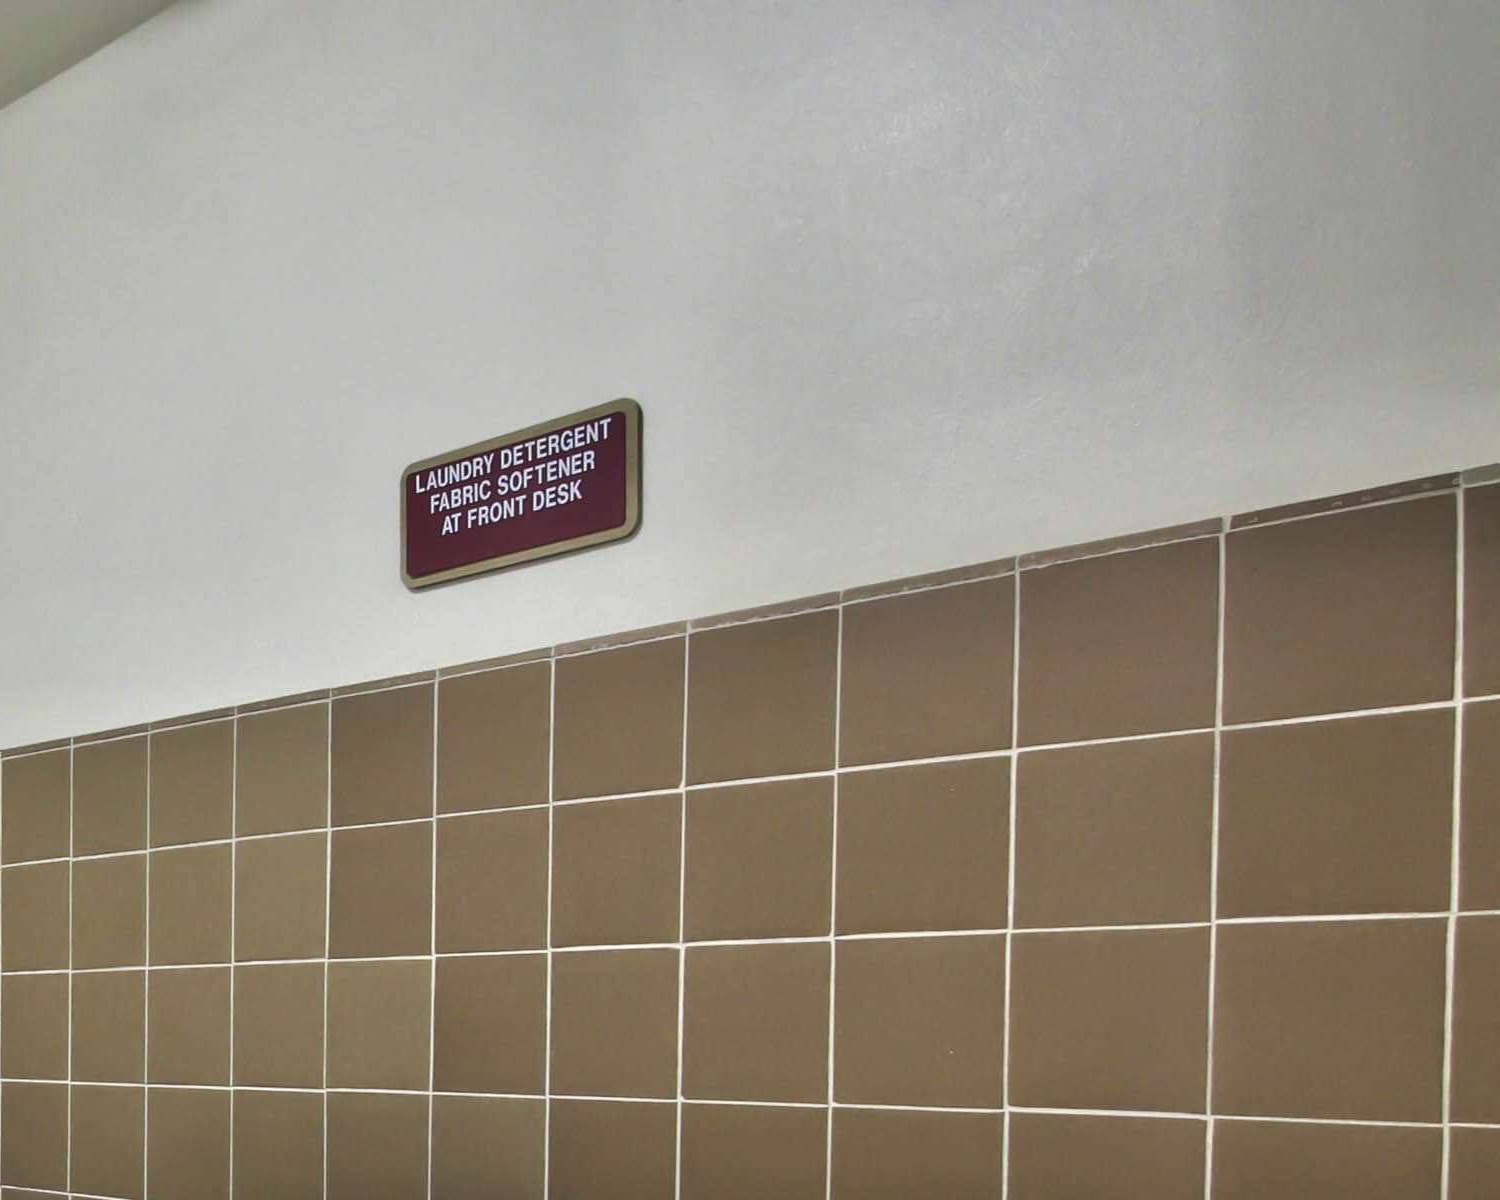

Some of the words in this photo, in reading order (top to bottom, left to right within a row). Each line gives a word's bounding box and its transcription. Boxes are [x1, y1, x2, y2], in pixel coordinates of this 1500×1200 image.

[415, 453, 495, 494] LAUNDRY
[500, 418, 612, 469] DETERGENT
[430, 480, 491, 514] FABRIC
[497, 450, 596, 496] SOFTENER
[441, 513, 462, 536] AT
[467, 496, 527, 529] FRONT
[532, 479, 582, 512] DESK
